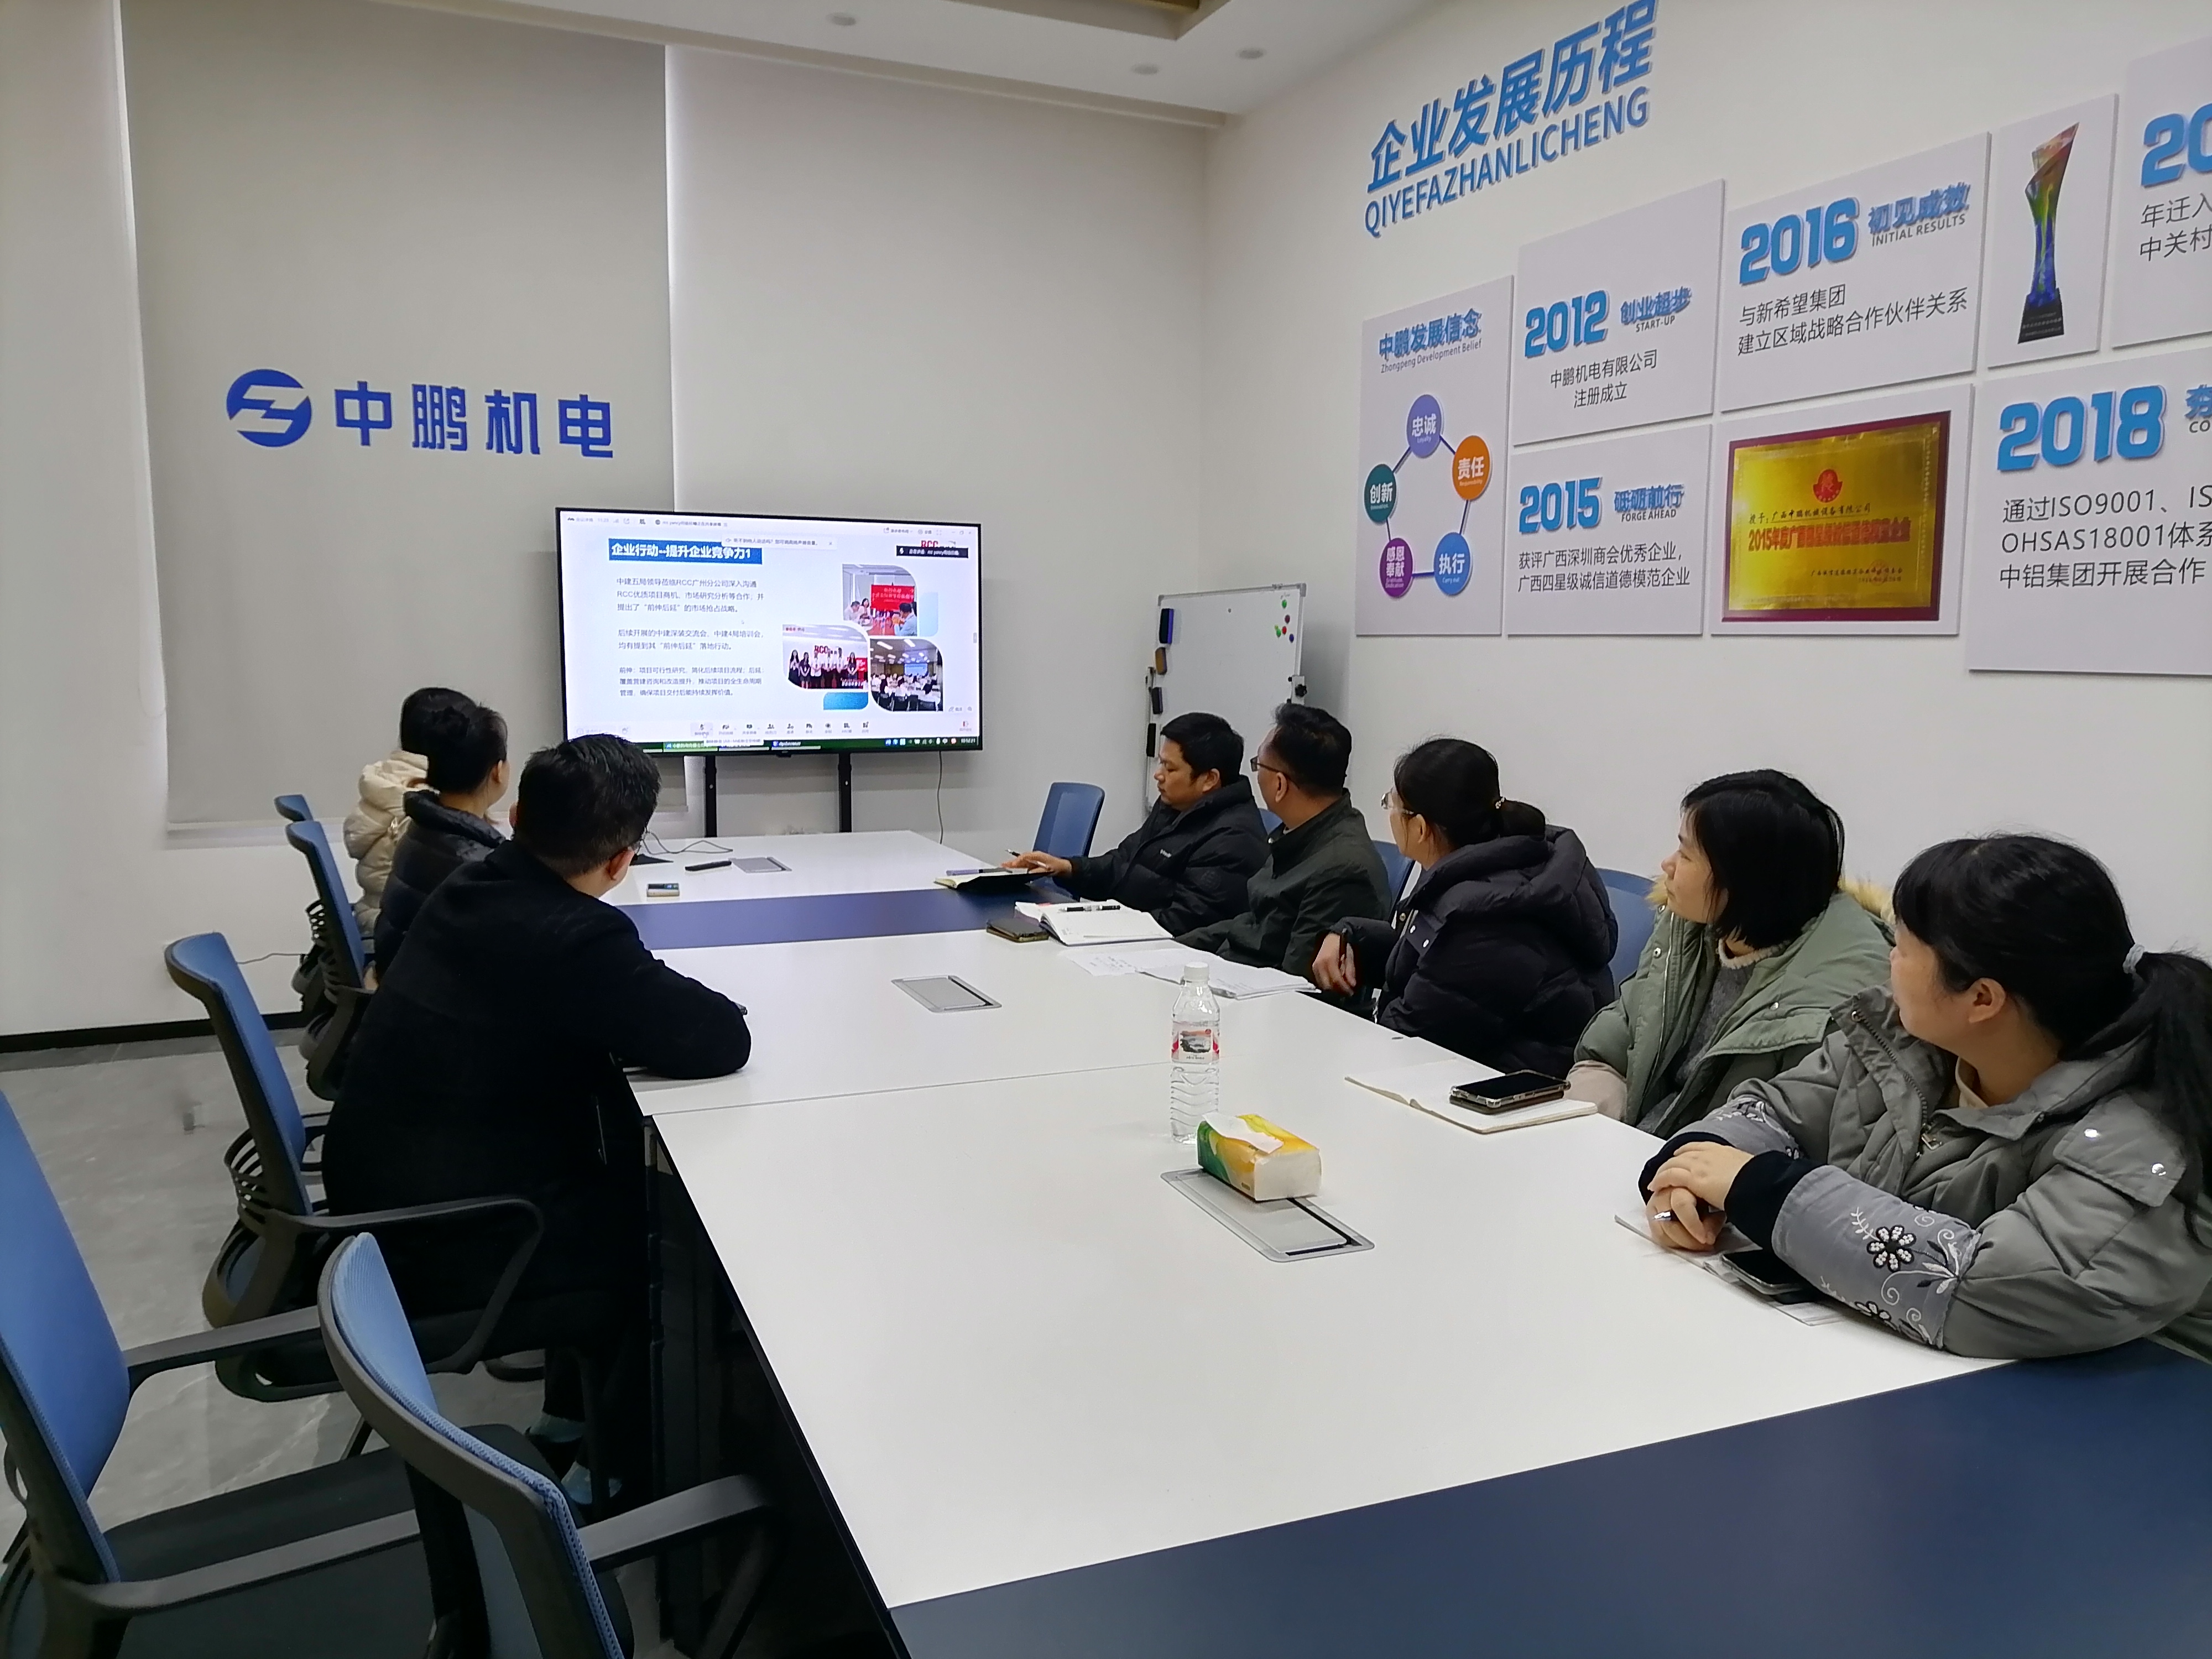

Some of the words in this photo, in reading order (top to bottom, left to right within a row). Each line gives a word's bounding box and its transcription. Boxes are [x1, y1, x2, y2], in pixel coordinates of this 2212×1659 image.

[1367, 0, 1658, 193] 企业发展历程
[1365, 86, 1650, 238] QIYEFAZHANLICHENG
[2141, 192, 2212, 228] 年迁入
[1739, 197, 1859, 285] 2016
[1872, 227, 1913, 247] INITIAL
[1916, 213, 1965, 236] RESULTS
[2140, 223, 2212, 261] 中关村
[1738, 287, 1968, 356] 建立区域战略合作伙伴关系
[1739, 284, 1846, 327] 与新希望集团
[1379, 308, 1482, 362] 中鹏发展信念
[1525, 290, 1609, 358] 2012
[1635, 315, 1676, 332] START-UP
[1381, 358, 1416, 373] Zhongpeng
[1417, 345, 1460, 364] Development
[1462, 338, 1482, 352] Belief
[1550, 349, 1657, 388] 中鹏机电有限公司
[1574, 381, 1627, 408] 注册成立
[335, 380, 613, 458] 中鹏机电
[1412, 413, 1437, 437] 忠诚
[1997, 385, 2166, 471] 2018
[2189, 420, 2211, 433] CO
[1458, 456, 1484, 480] 责任
[1370, 482, 1393, 504] 创新
[1519, 477, 1602, 535] 2015
[1621, 509, 1647, 523] FORGE
[1648, 509, 1677, 520] AHEAD
[1386, 546, 1405, 562] 感恩
[2001, 521, 2212, 553] OHSAS18001体系
[1386, 561, 1405, 577] 奉献
[1439, 553, 1465, 575] 执行
[1517, 566, 1691, 592] 广西四星级诚信道德模范企业
[2000, 557, 2206, 589] 中铝集团开展合作
